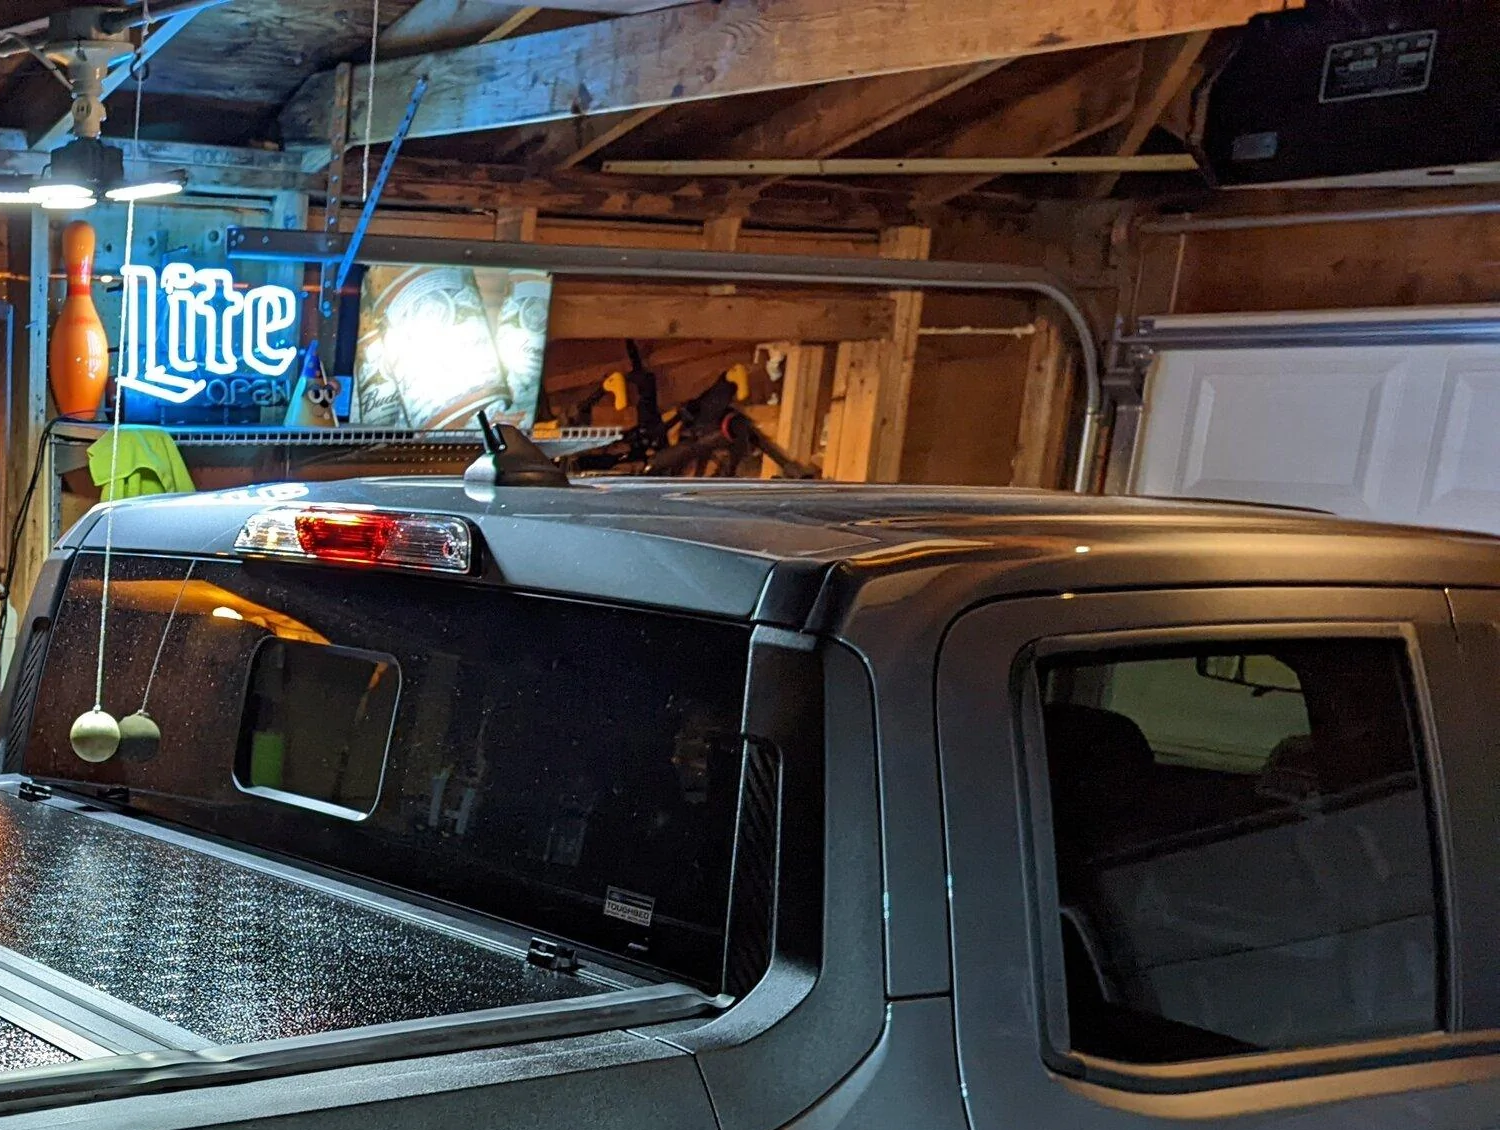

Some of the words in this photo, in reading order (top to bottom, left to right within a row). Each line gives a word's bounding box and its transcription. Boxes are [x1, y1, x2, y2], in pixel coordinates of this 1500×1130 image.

[115, 263, 297, 403] Lite
[206, 378, 290, 405] OPEN
[607, 901, 649, 920] TOUGHBED
